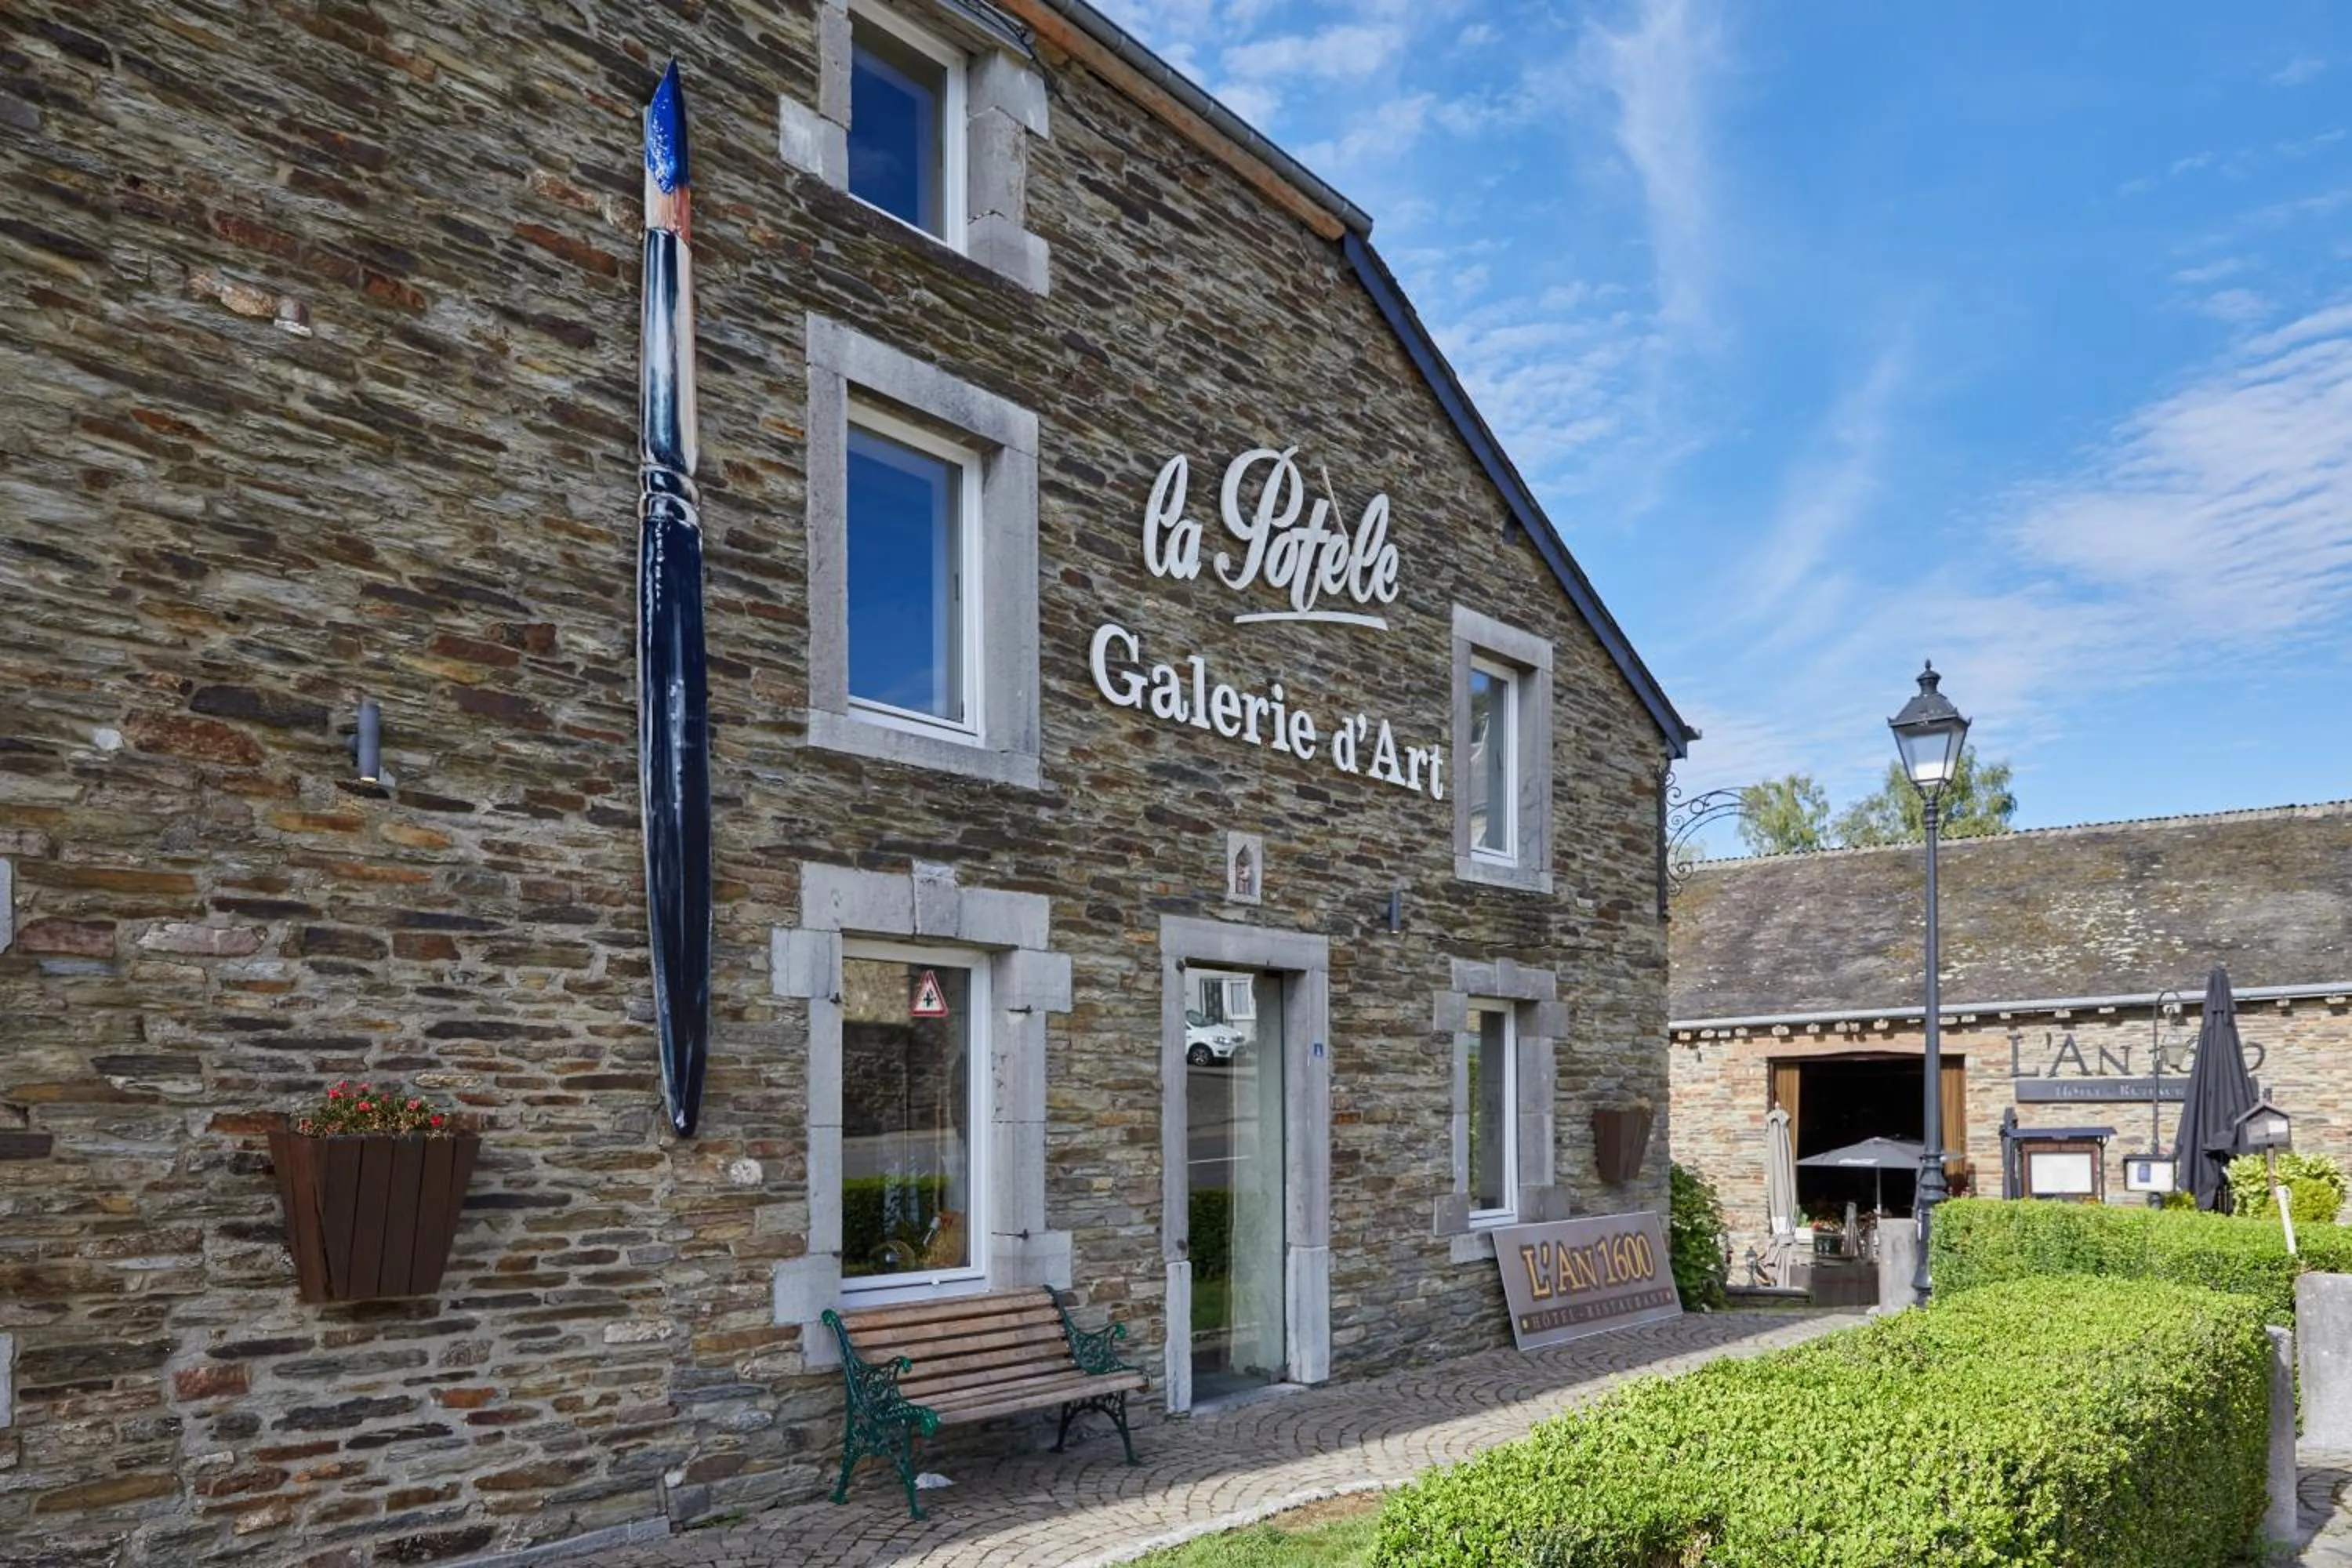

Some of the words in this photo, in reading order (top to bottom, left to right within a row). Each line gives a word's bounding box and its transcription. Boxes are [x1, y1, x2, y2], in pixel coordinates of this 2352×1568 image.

[1142, 454, 1203, 580] la
[1089, 624, 1317, 760] Galerie
[1333, 713, 1445, 800] d'Art
[2007, 1032, 2132, 1077] L'AN
[1597, 1233, 1654, 1284] 1600
